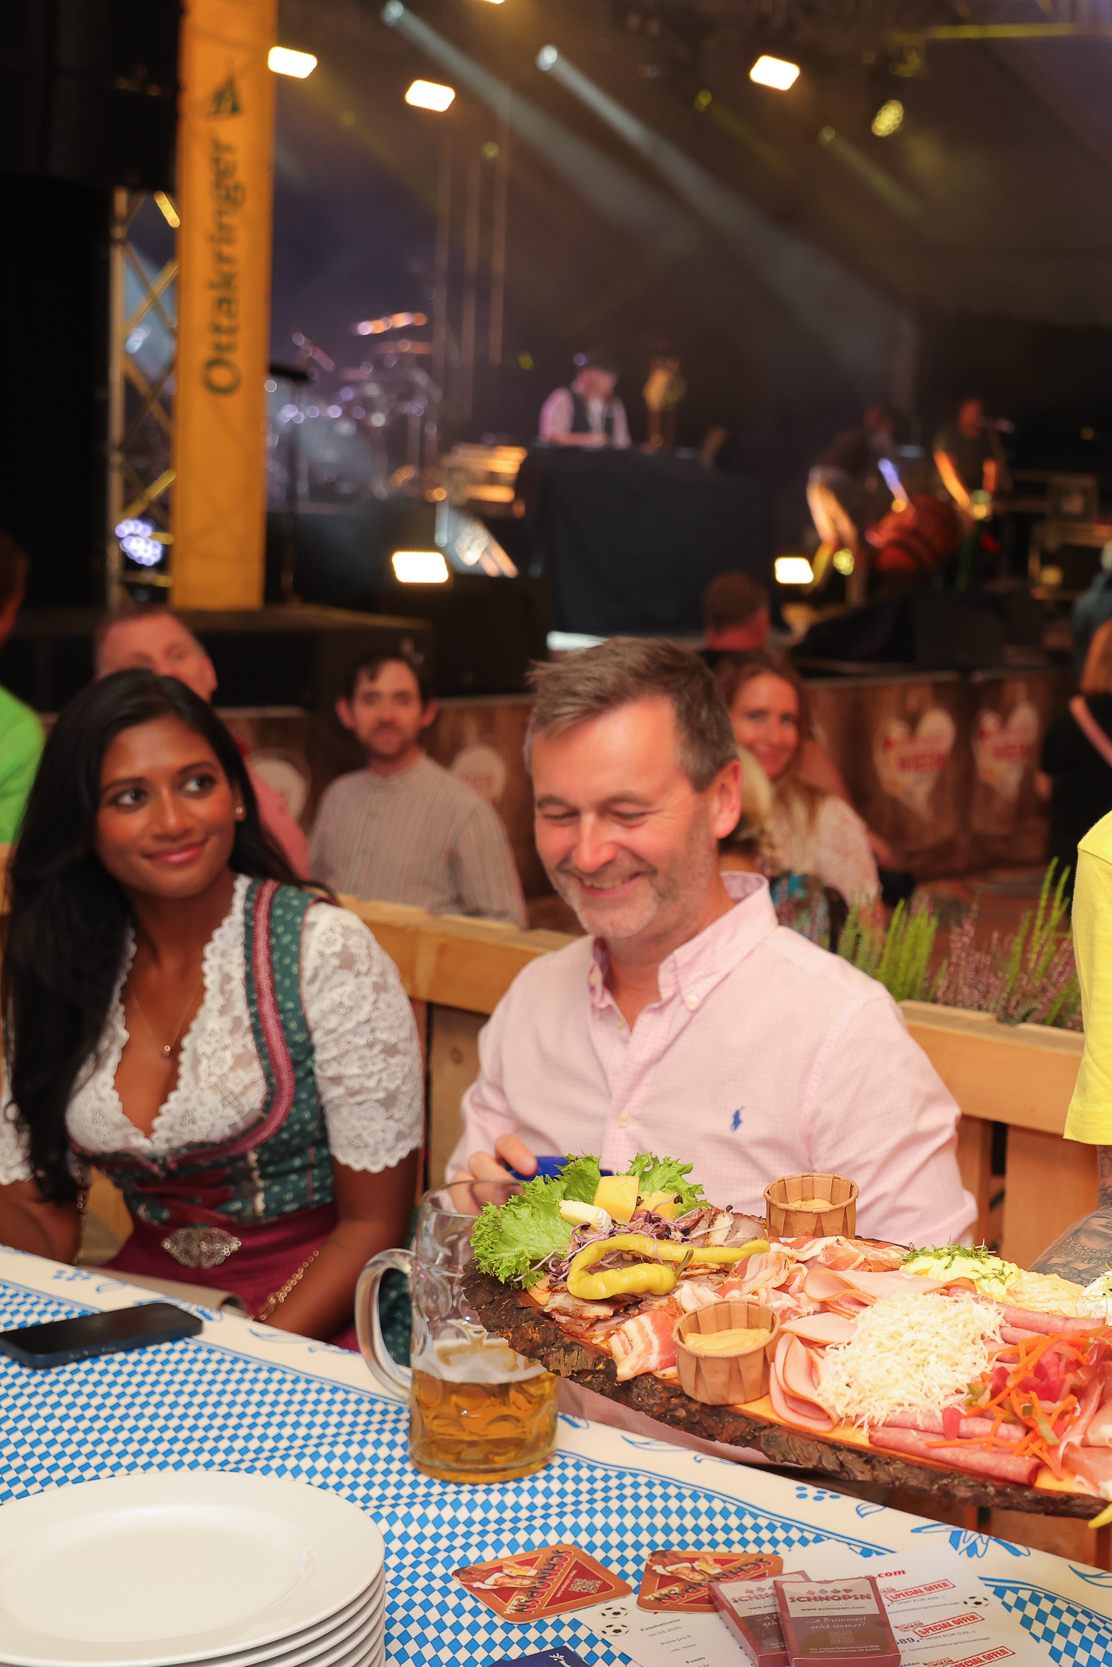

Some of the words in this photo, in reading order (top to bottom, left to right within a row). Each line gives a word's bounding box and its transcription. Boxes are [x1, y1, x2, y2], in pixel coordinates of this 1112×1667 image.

[202, 137, 246, 396] Ottakringer
[789, 1593, 872, 1602] SCHNOPSN
[919, 1621, 953, 1635] SPECIAL
[952, 1613, 979, 1626] OFFER
[982, 1648, 1009, 1661] OFFER
